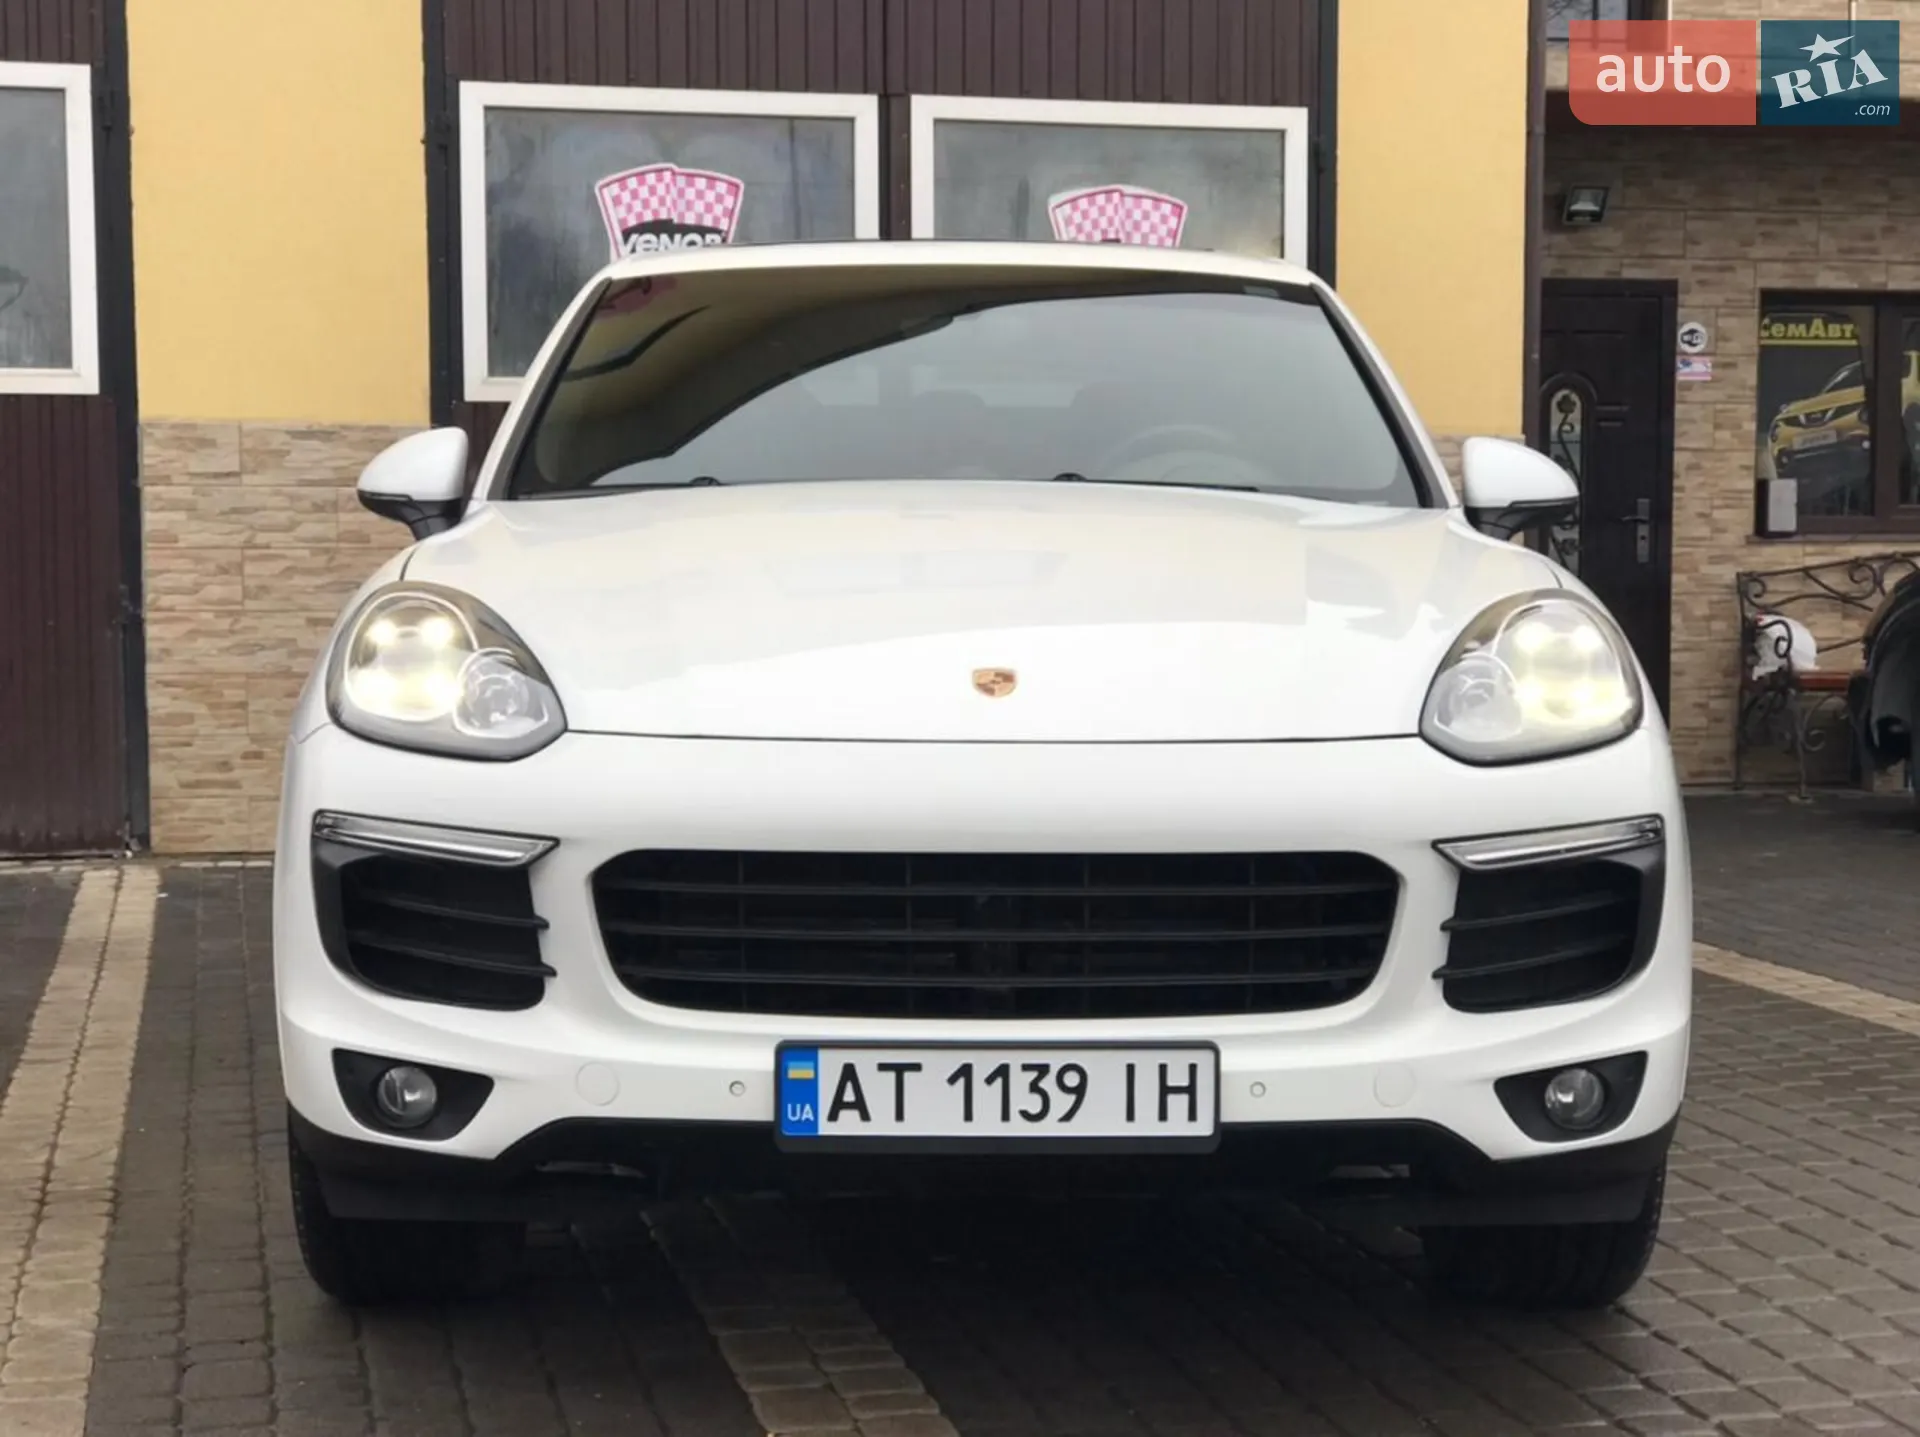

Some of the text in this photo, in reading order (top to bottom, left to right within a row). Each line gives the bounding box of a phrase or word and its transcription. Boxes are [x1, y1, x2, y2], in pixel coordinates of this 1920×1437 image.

[787, 1103, 815, 1122] UA
[827, 1062, 1199, 1123] AT 1139 IH
